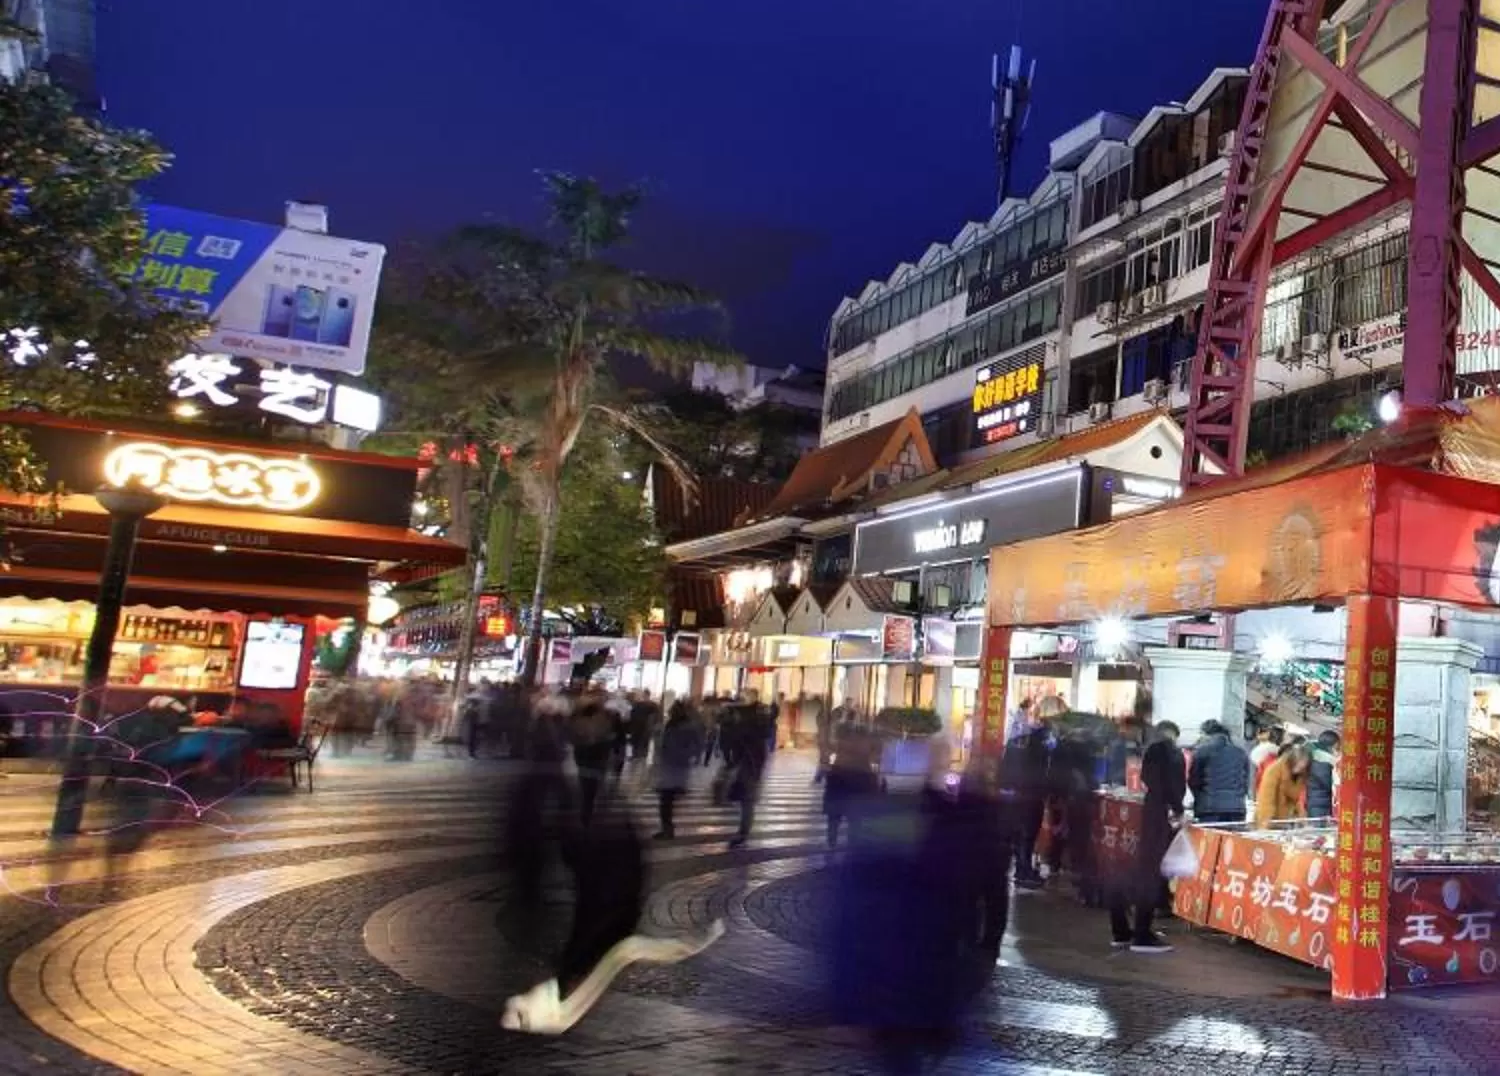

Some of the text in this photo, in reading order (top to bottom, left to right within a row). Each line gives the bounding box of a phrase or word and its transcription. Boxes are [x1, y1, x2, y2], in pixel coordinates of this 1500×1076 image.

[1359, 647, 1389, 947] 创建文明城市 构建和谐桂林
